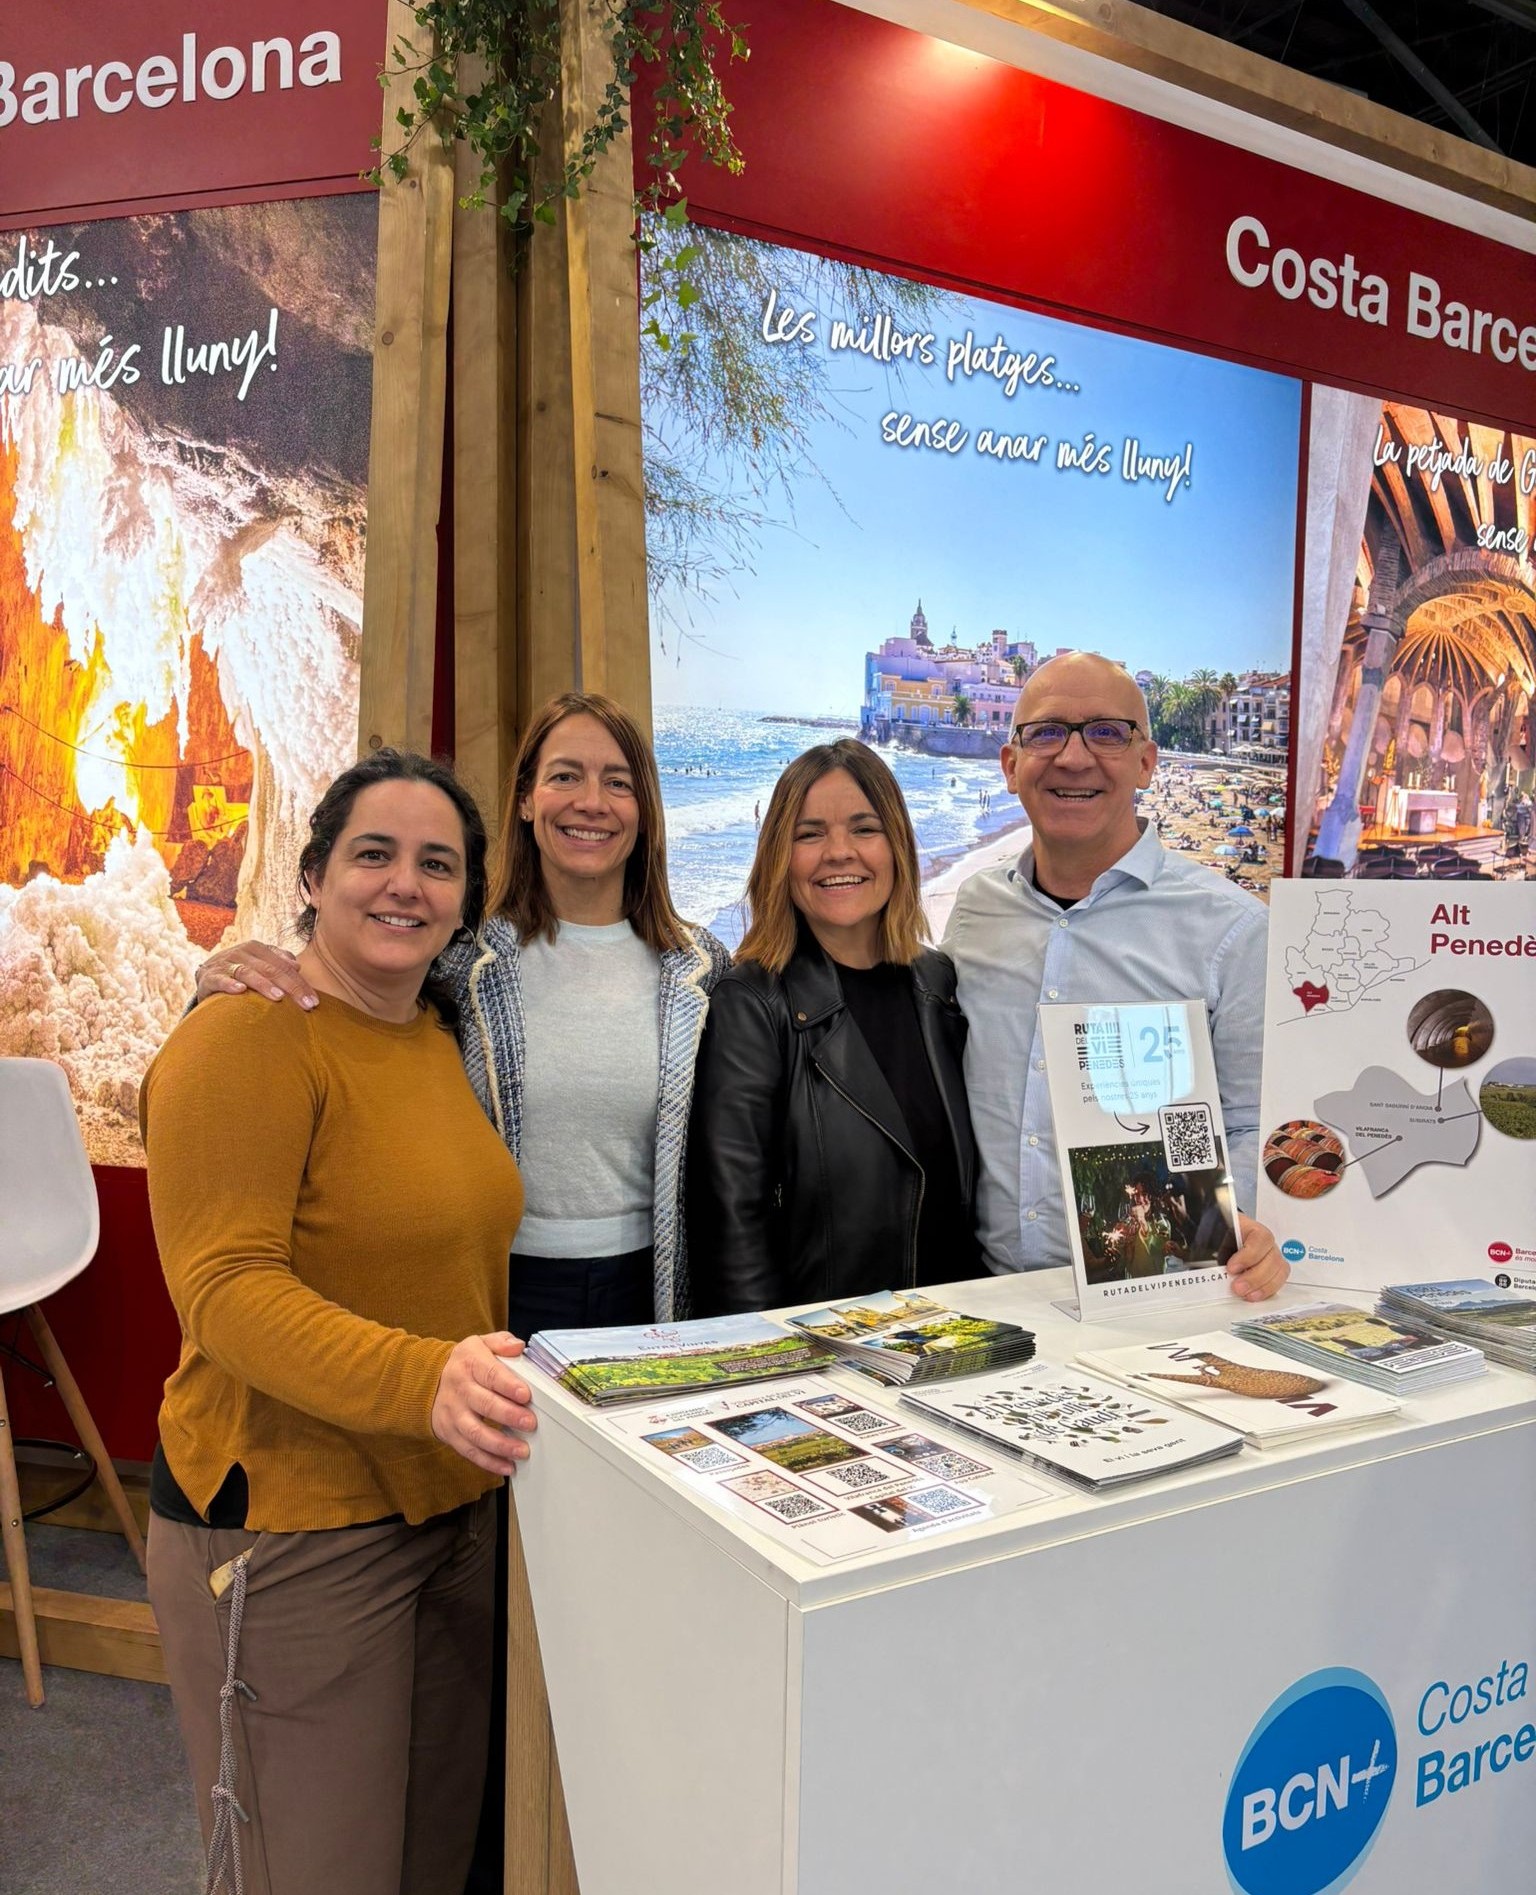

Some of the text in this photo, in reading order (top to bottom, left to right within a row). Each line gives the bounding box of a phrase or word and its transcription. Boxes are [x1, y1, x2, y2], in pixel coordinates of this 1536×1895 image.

[1226, 215, 1536, 371] Costa Barce
[58, 335, 141, 394] més
[161, 307, 280, 400] lluny!
[762, 289, 1081, 396] Les millors platges...
[881, 411, 1193, 501] sense anar més lluny!
[1373, 424, 1402, 466] La
[1406, 436, 1484, 491] petjada
[1488, 443, 1514, 484] de
[1476, 523, 1529, 553] sense
[1430, 903, 1470, 925] Alt
[1430, 933, 1536, 957] Penedè
[1139, 1026, 1182, 1063] 25
[1103, 1271, 1229, 1297] RUTADELVIPENEDES.CAT
[1309, 1253, 1344, 1262] Barcelona
[1418, 1660, 1528, 1736] Costa
[1416, 1723, 1536, 1808] Barce
